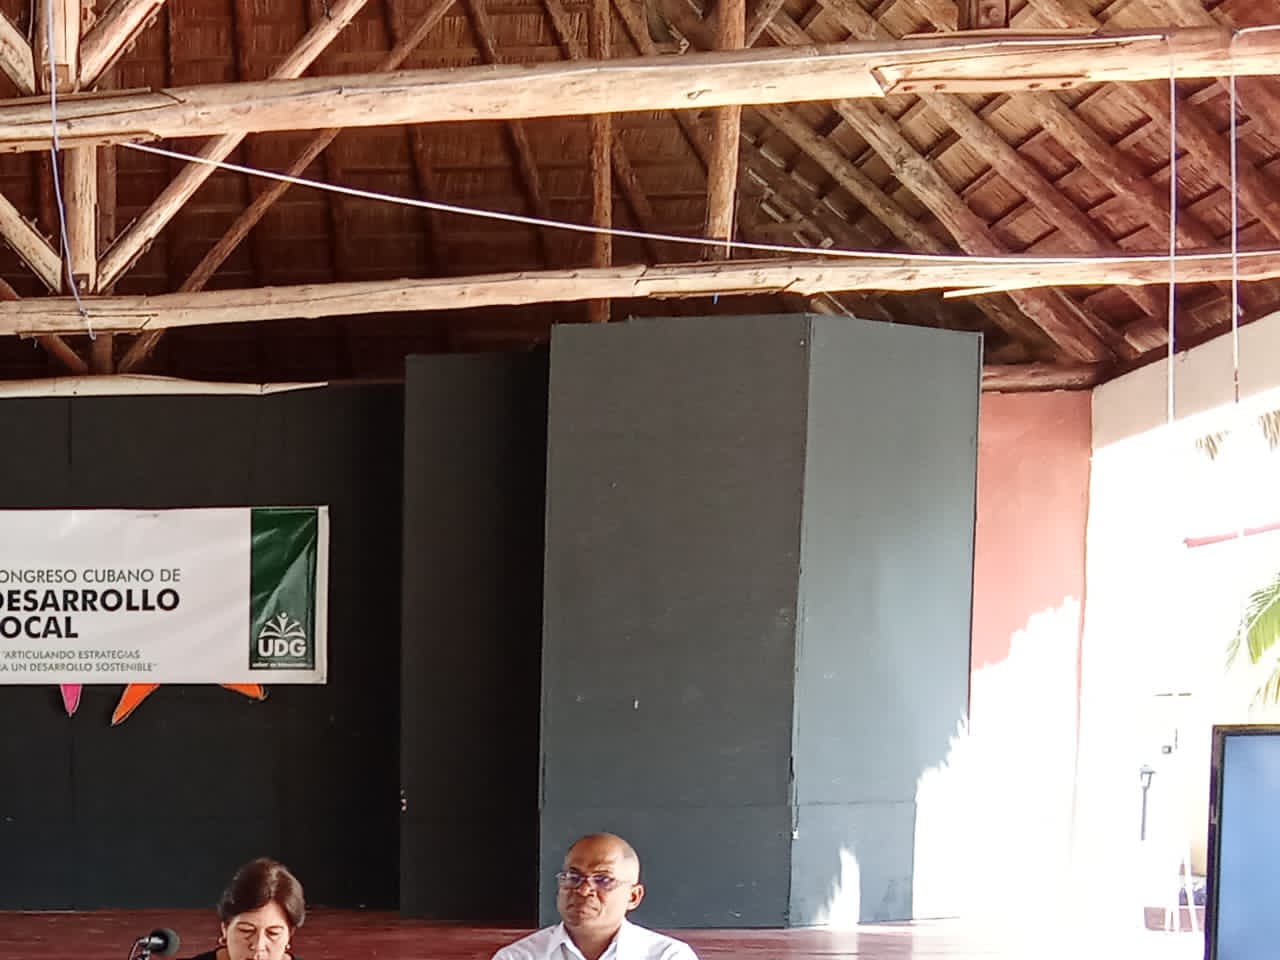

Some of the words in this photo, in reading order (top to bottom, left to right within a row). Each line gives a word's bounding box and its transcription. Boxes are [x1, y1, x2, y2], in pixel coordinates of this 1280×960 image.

[83, 568, 155, 583] CUBANO
[160, 568, 181, 583] DE
[258, 639, 307, 657] UDG
[11, 663, 27, 672] UN
[29, 662, 93, 672] DESARROLLO
